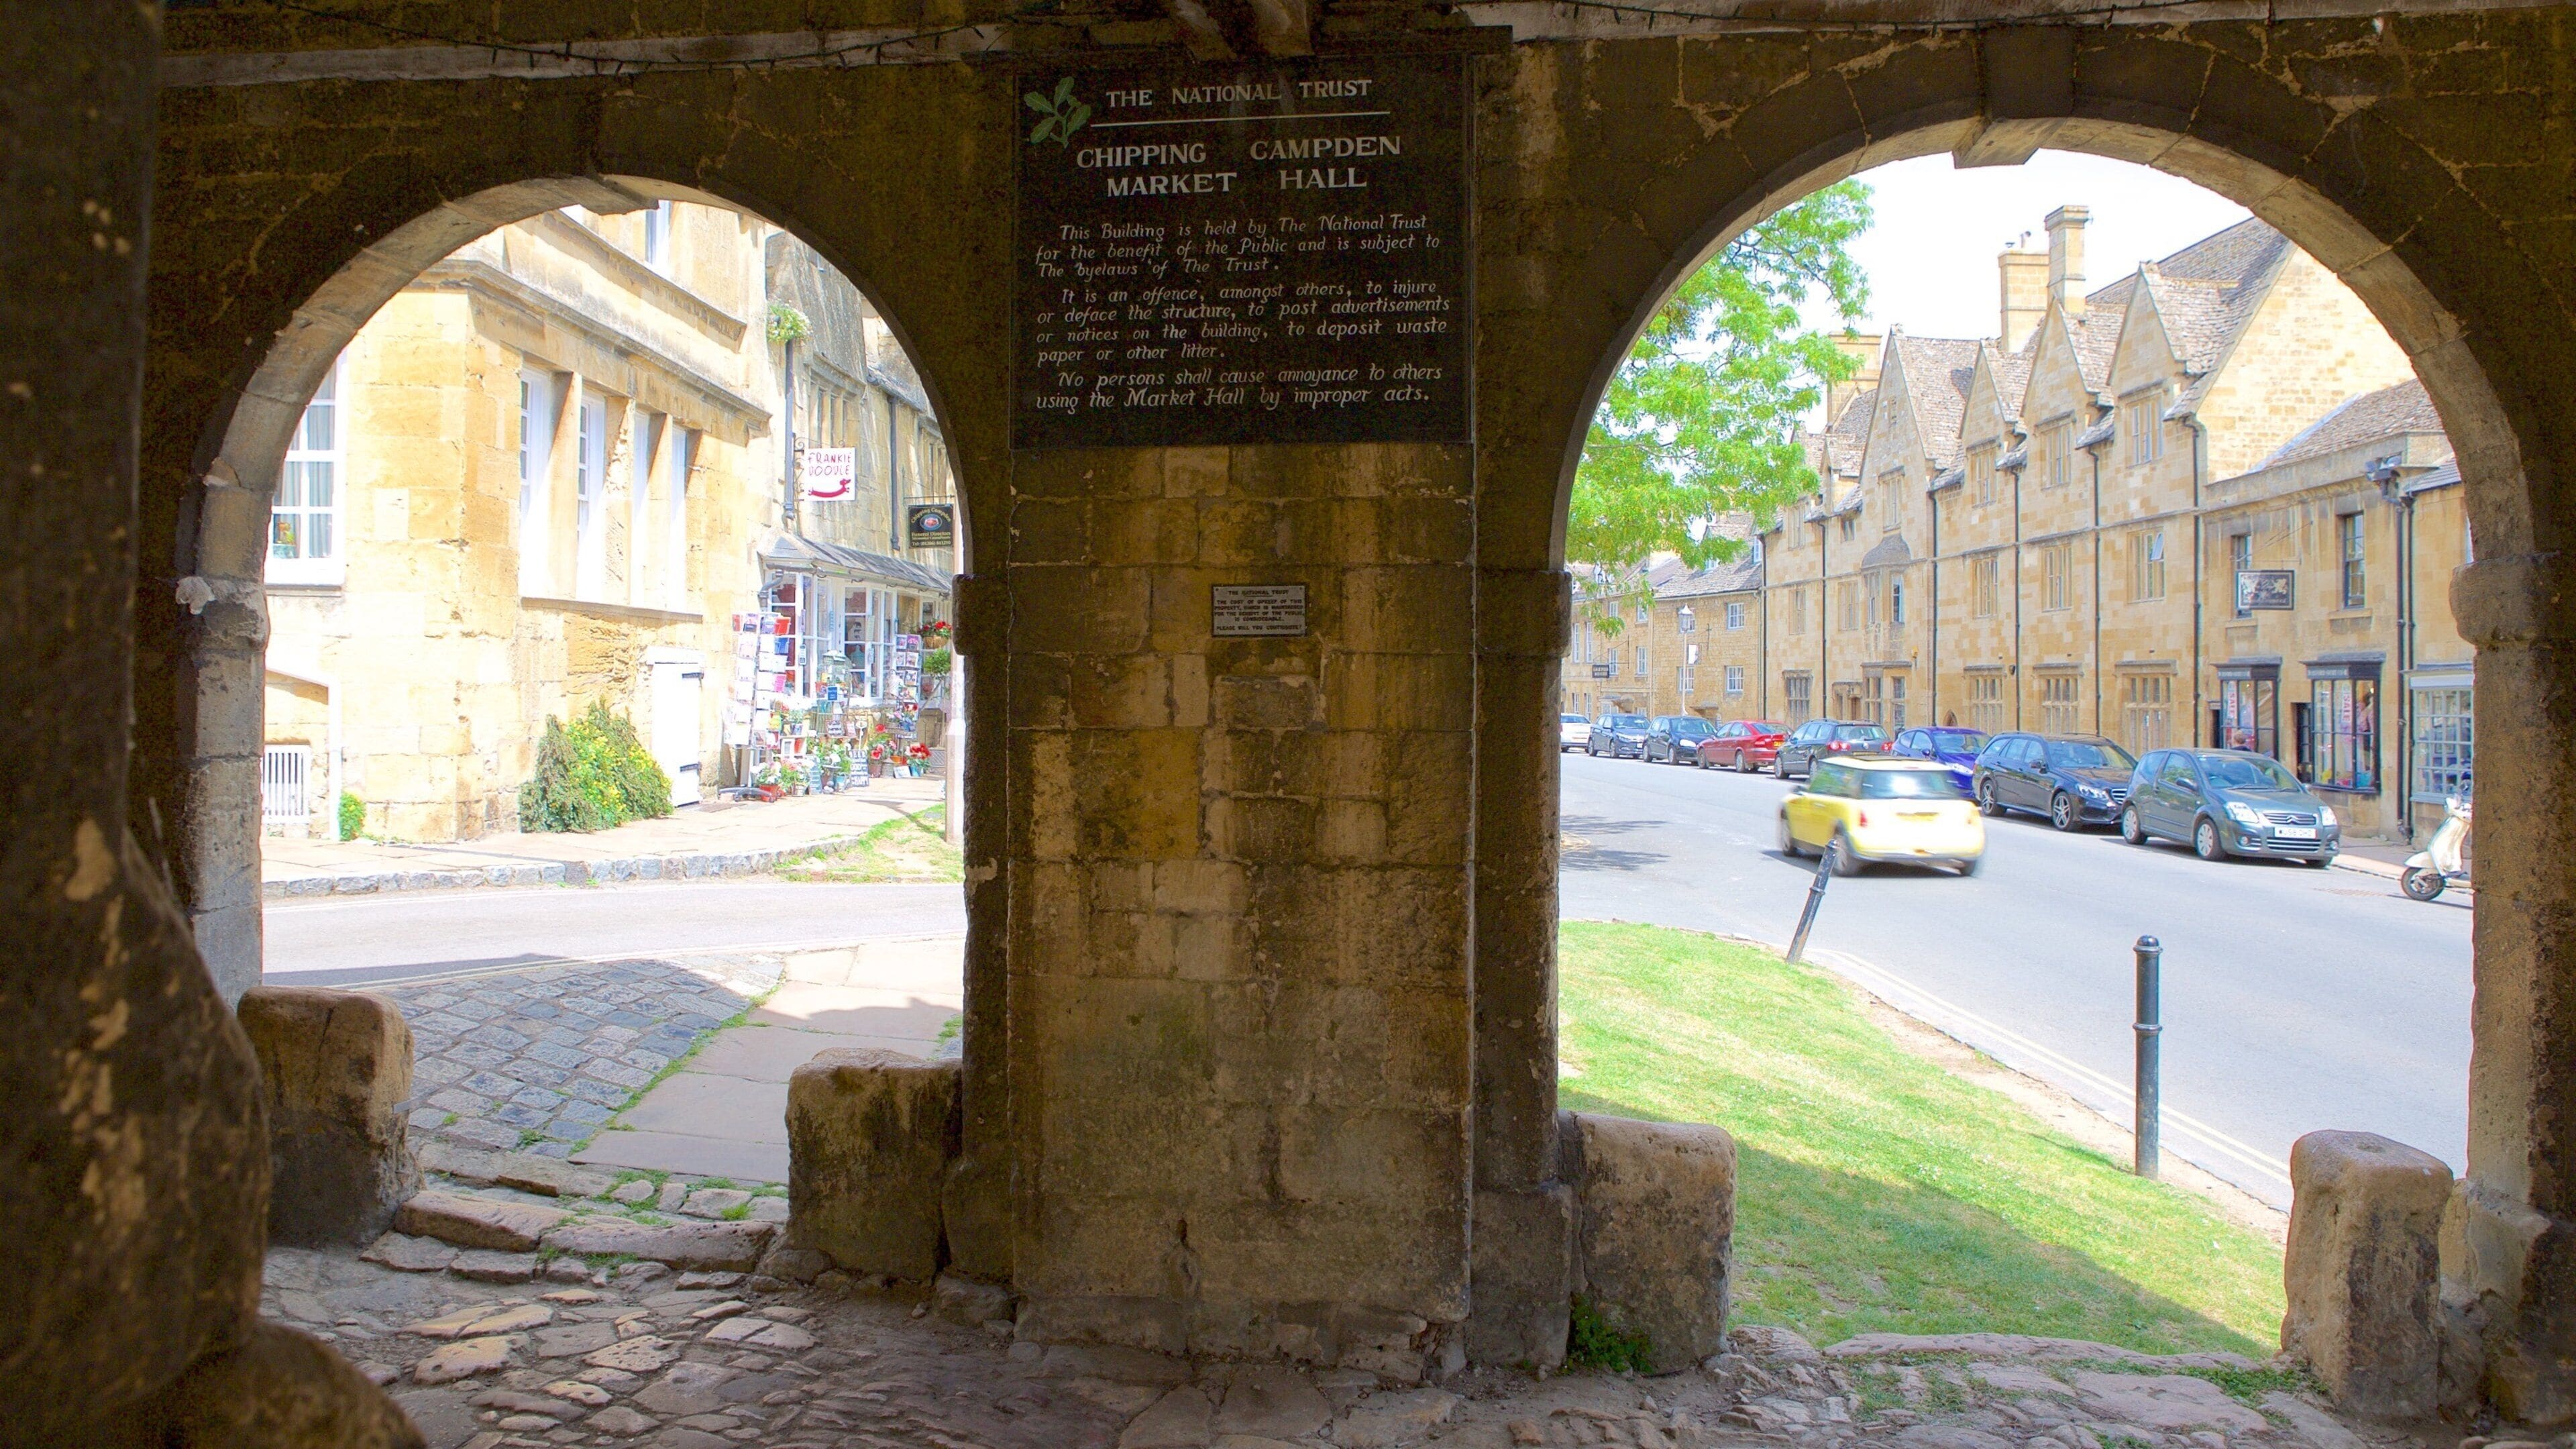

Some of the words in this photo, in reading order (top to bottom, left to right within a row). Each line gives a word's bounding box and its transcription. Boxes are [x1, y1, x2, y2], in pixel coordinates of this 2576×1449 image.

[1106, 89, 1153, 107] THE
[1171, 84, 1281, 104] NATIONAL
[1298, 79, 1372, 98] TRUST
[1077, 143, 1206, 168] CHIPPING
[1250, 136, 1401, 160] CAMPDEN
[1107, 172, 1237, 197] MARKET
[1279, 168, 1367, 190] HALL
[1060, 225, 1090, 240] This
[1102, 223, 1165, 241] Building
[1179, 223, 1191, 235] is
[1204, 220, 1236, 235] held
[1248, 219, 1267, 238] by
[1279, 217, 1307, 232] The
[1318, 215, 1384, 230] National
[1390, 213, 1428, 229] Trust
[1036, 246, 1060, 264] for
[1071, 244, 1095, 259] the
[1108, 244, 1162, 261] benefit
[1177, 240, 1193, 260] of
[1205, 241, 1228, 254] the
[1237, 237, 1287, 254] Public
[1298, 236, 1326, 252] and
[1338, 237, 1350, 250] is
[1360, 234, 1415, 254] subject
[1426, 234, 1440, 248] to
[1038, 262, 1064, 277] The
[1075, 262, 1138, 282] byelaws
[1152, 260, 1169, 279] of
[1183, 257, 1210, 273] The
[1226, 257, 1279, 272] Trust.
[1062, 288, 1075, 304] It
[1085, 289, 1097, 303] is
[1108, 290, 1128, 303] an
[1142, 286, 1205, 305] offence,
[1220, 283, 1284, 303] amongst
[1296, 282, 1351, 297] others,
[1366, 280, 1382, 294] to
[1393, 280, 1436, 298] injure
[1037, 312, 1055, 323] or
[1065, 307, 1117, 327] deface
[1128, 305, 1152, 320] the
[1161, 303, 1236, 321] structure,
[1248, 303, 1264, 316] to
[1279, 301, 1318, 321] post
[1331, 296, 1450, 314] advertisements
[1036, 332, 1054, 343] or
[1067, 327, 1118, 342] notices
[1133, 329, 1150, 339] on
[1163, 324, 1187, 339] the
[1201, 323, 1268, 343] building,
[1287, 321, 1305, 335] to
[1317, 319, 1383, 341] deposit
[1396, 317, 1447, 334] waste
[1038, 351, 1084, 368] paper
[1096, 349, 1113, 360] or
[1126, 345, 1169, 359] other
[1181, 343, 1225, 358] litter.
[1058, 372, 1083, 387] No
[1095, 372, 1165, 391] persons
[1175, 368, 1212, 385] shall
[1220, 370, 1265, 384] cause
[1278, 370, 1358, 386] annoyance
[1369, 363, 1385, 380] to
[1393, 364, 1442, 380] others
[1036, 392, 1079, 415] using
[1089, 392, 1114, 408] the
[1124, 387, 1195, 407] Market
[1204, 388, 1244, 406] Hall
[1260, 386, 1279, 410] by
[1294, 387, 1371, 409] improper
[1384, 385, 1429, 401] acts.
[808, 452, 852, 464] FRANKIE
